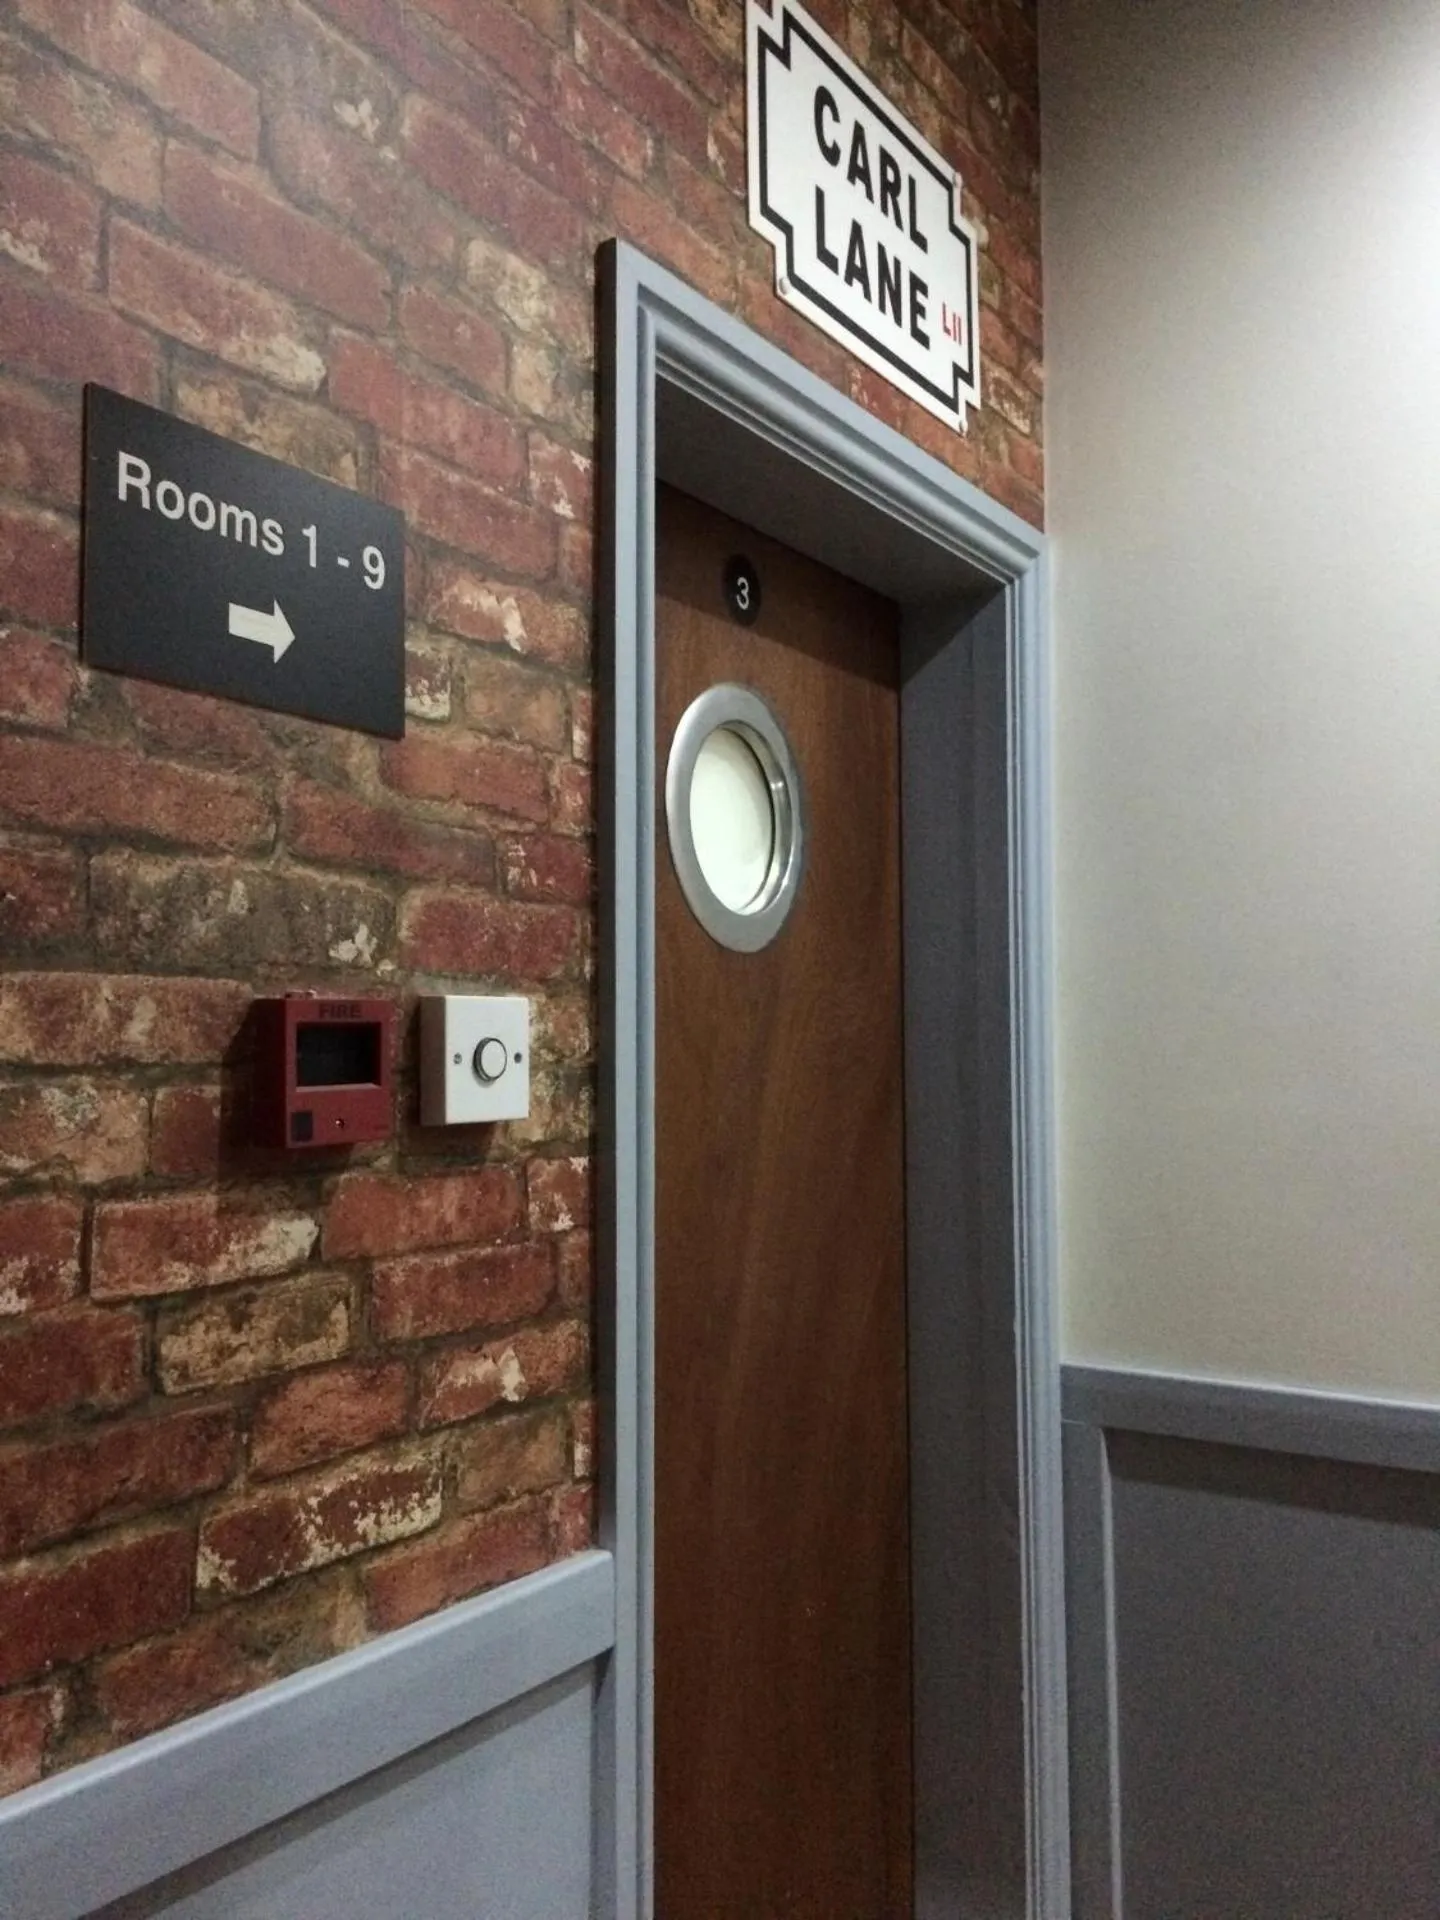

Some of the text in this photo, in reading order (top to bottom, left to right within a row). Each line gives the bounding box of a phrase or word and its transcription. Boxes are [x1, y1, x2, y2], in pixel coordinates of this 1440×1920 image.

[813, 84, 928, 254] CARL
[815, 184, 931, 351] LANE
[118, 450, 285, 556] Rooms
[301, 524, 317, 568] 1
[362, 545, 386, 590] 9
[736, 576, 749, 610] 3
[318, 1003, 363, 1019] FIRE
